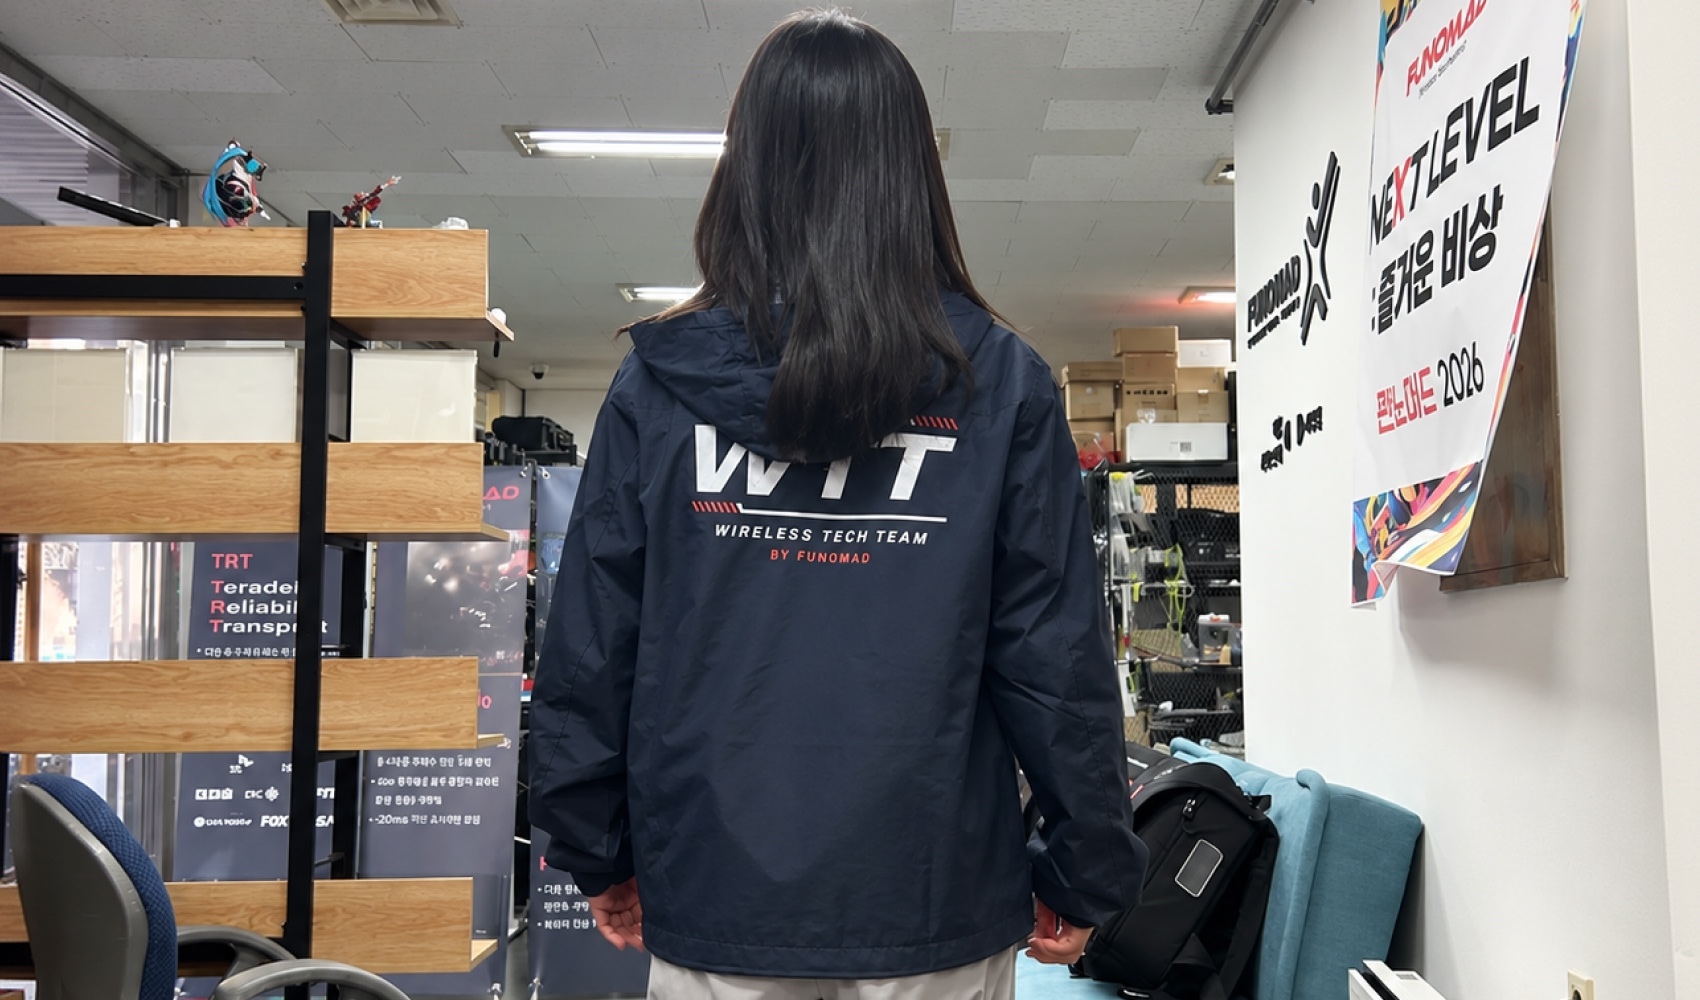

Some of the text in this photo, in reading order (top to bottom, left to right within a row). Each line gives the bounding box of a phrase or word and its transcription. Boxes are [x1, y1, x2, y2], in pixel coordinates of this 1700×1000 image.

[1371, 140, 1430, 245] NEXT
[1426, 56, 1540, 198] LEVEL
[1441, 183, 1504, 289] 비상
[1437, 341, 1484, 407] 2026
[714, 524, 928, 545] WIRELESS TECH TEAM
[211, 553, 253, 570] TRT
[770, 549, 871, 564] BY FUNOMAD
[209, 619, 328, 637] Transpt
